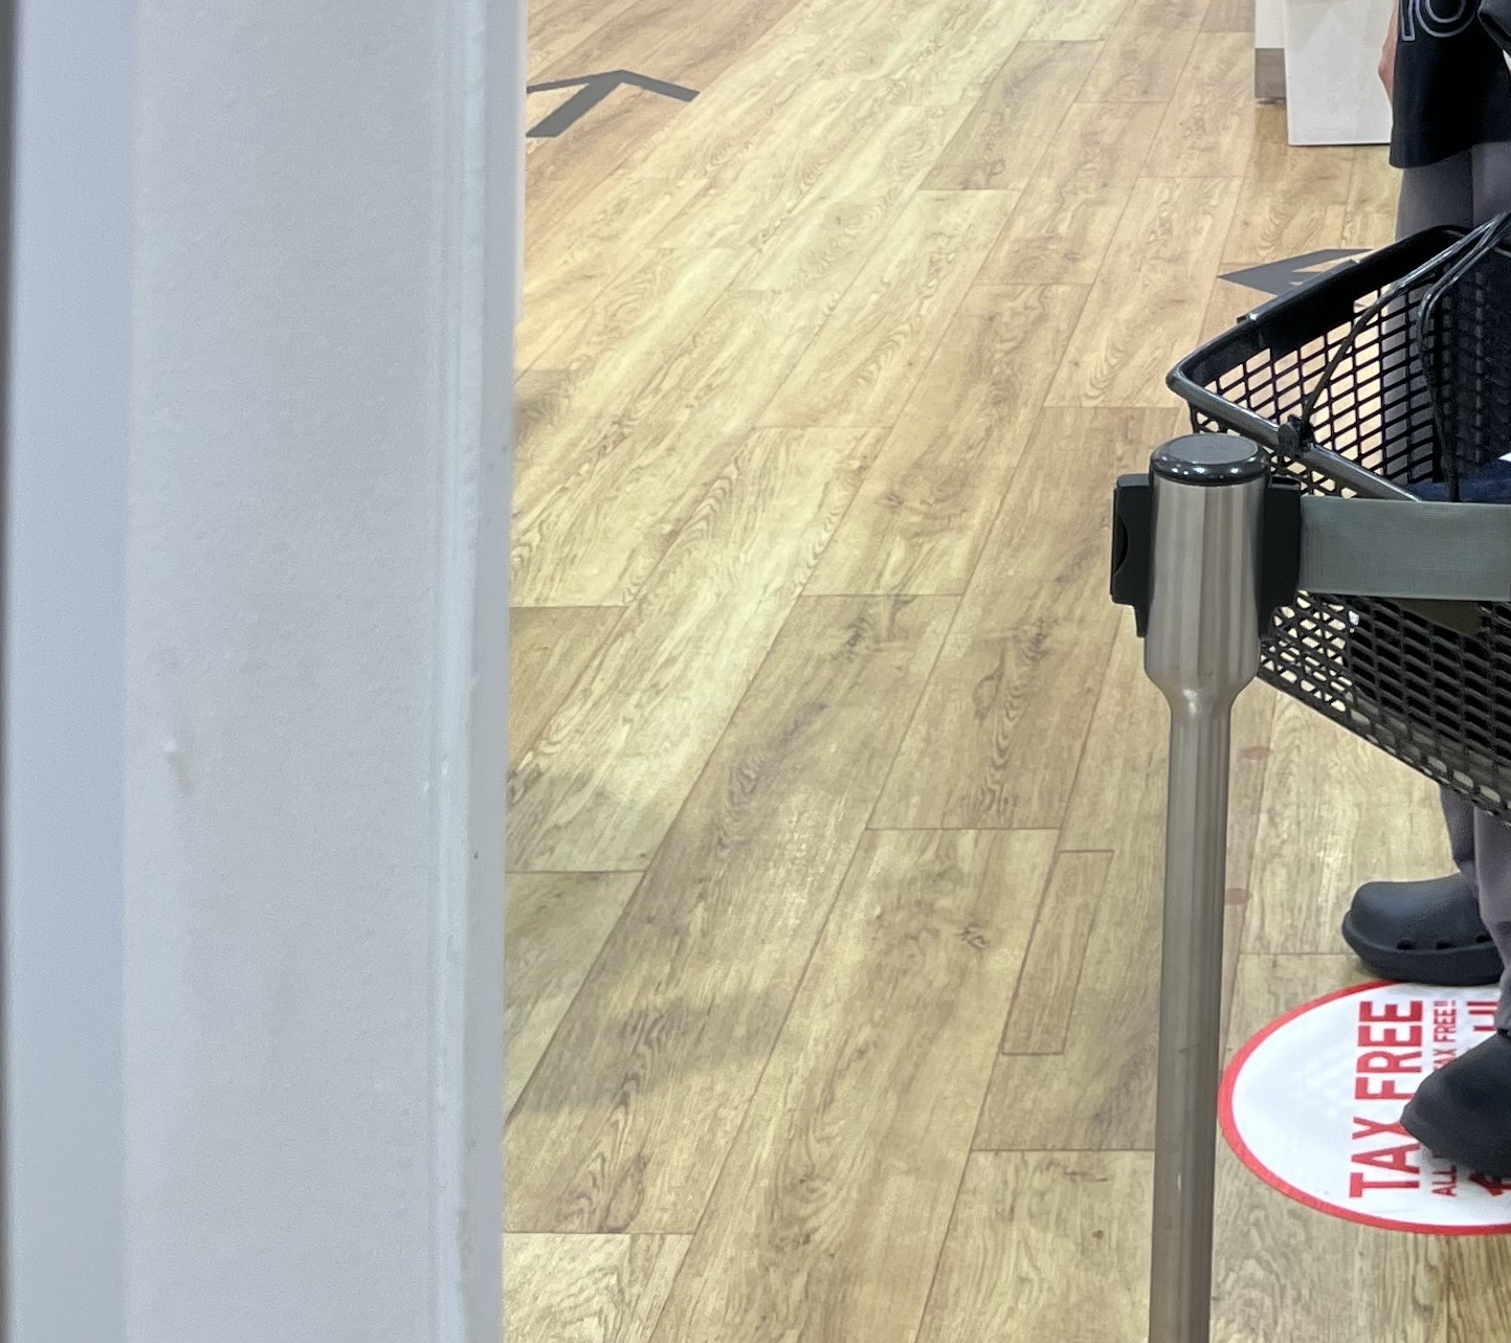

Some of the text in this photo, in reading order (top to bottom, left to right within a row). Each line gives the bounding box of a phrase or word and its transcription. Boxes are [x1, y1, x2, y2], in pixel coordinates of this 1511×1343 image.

[1433, 1000, 1457, 1042] FREE!!
[1349, 1000, 1423, 1197] TAX FREE
